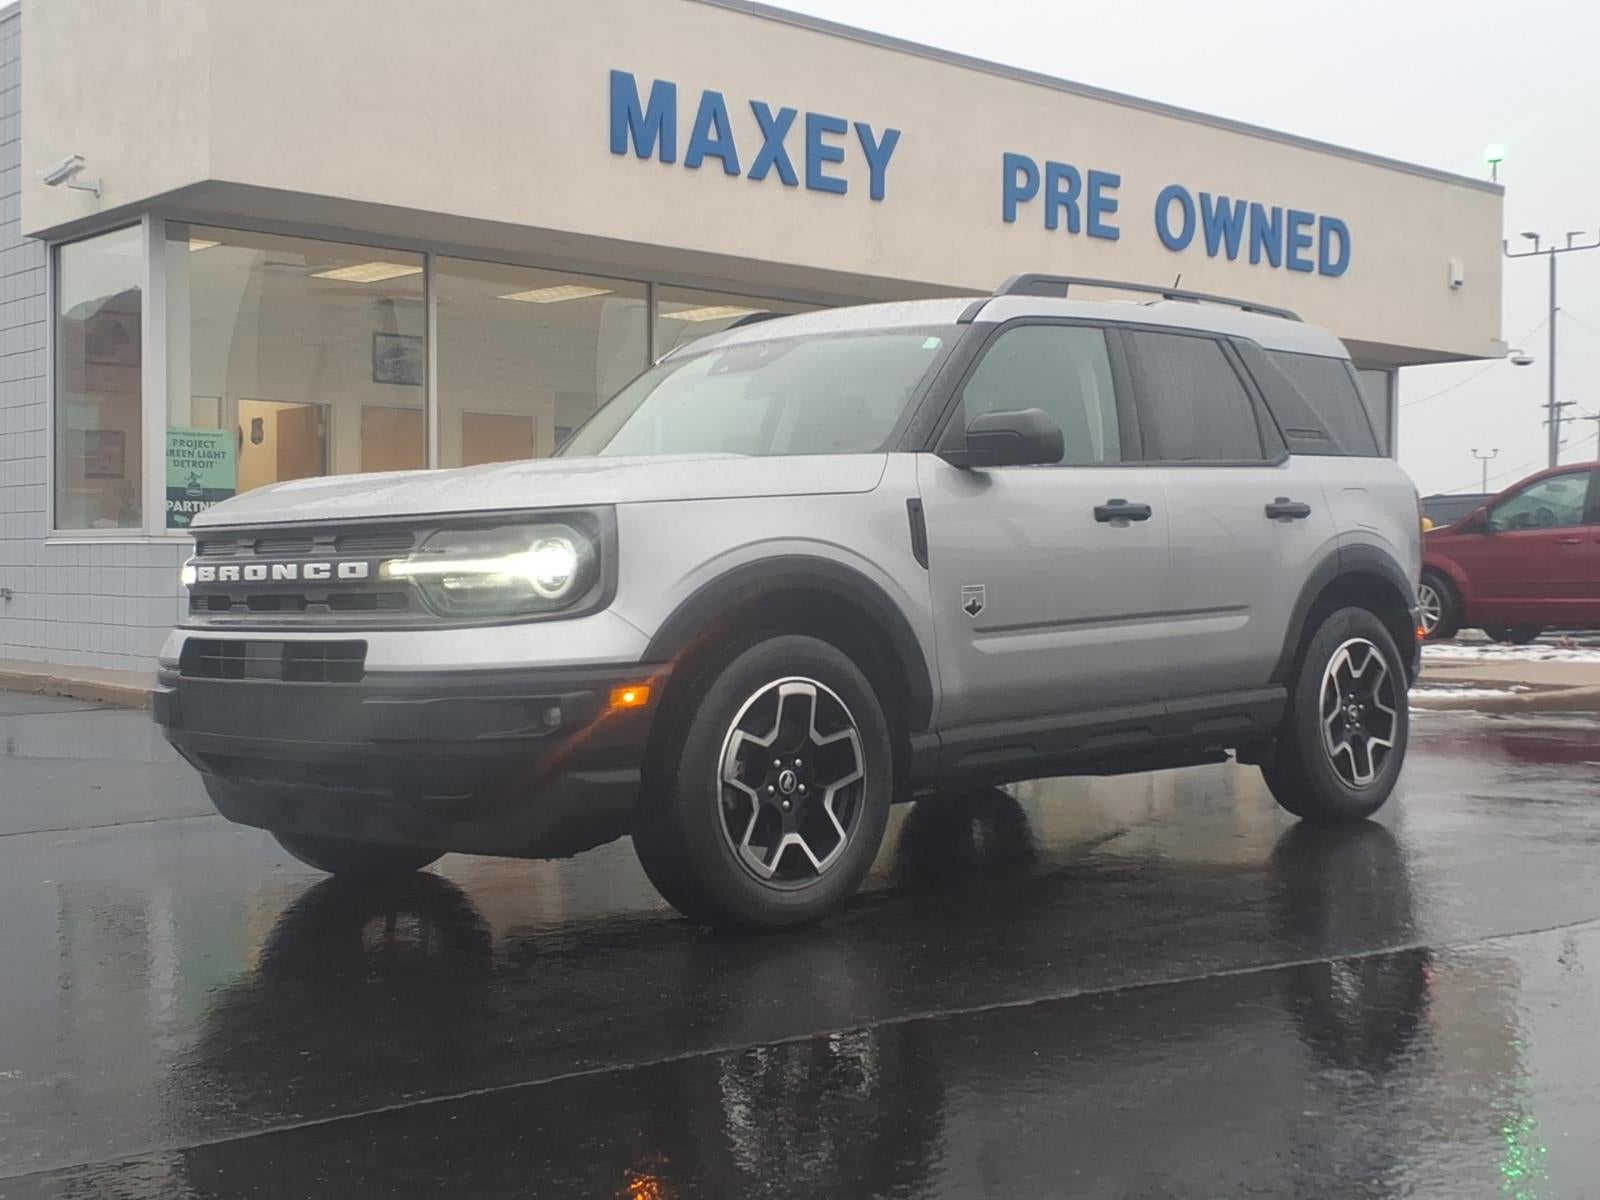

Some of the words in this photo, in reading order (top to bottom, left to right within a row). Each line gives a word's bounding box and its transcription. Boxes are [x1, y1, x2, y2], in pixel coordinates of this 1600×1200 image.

[609, 69, 901, 202] MAXEY
[1002, 152, 1121, 241] PRE
[1154, 184, 1351, 277] OWNED
[172, 439, 216, 449] PROJECT
[166, 449, 194, 458] REEN
[197, 450, 227, 459] LIGHT
[173, 459, 214, 469] DETROIT
[197, 561, 368, 582] BRONCO
